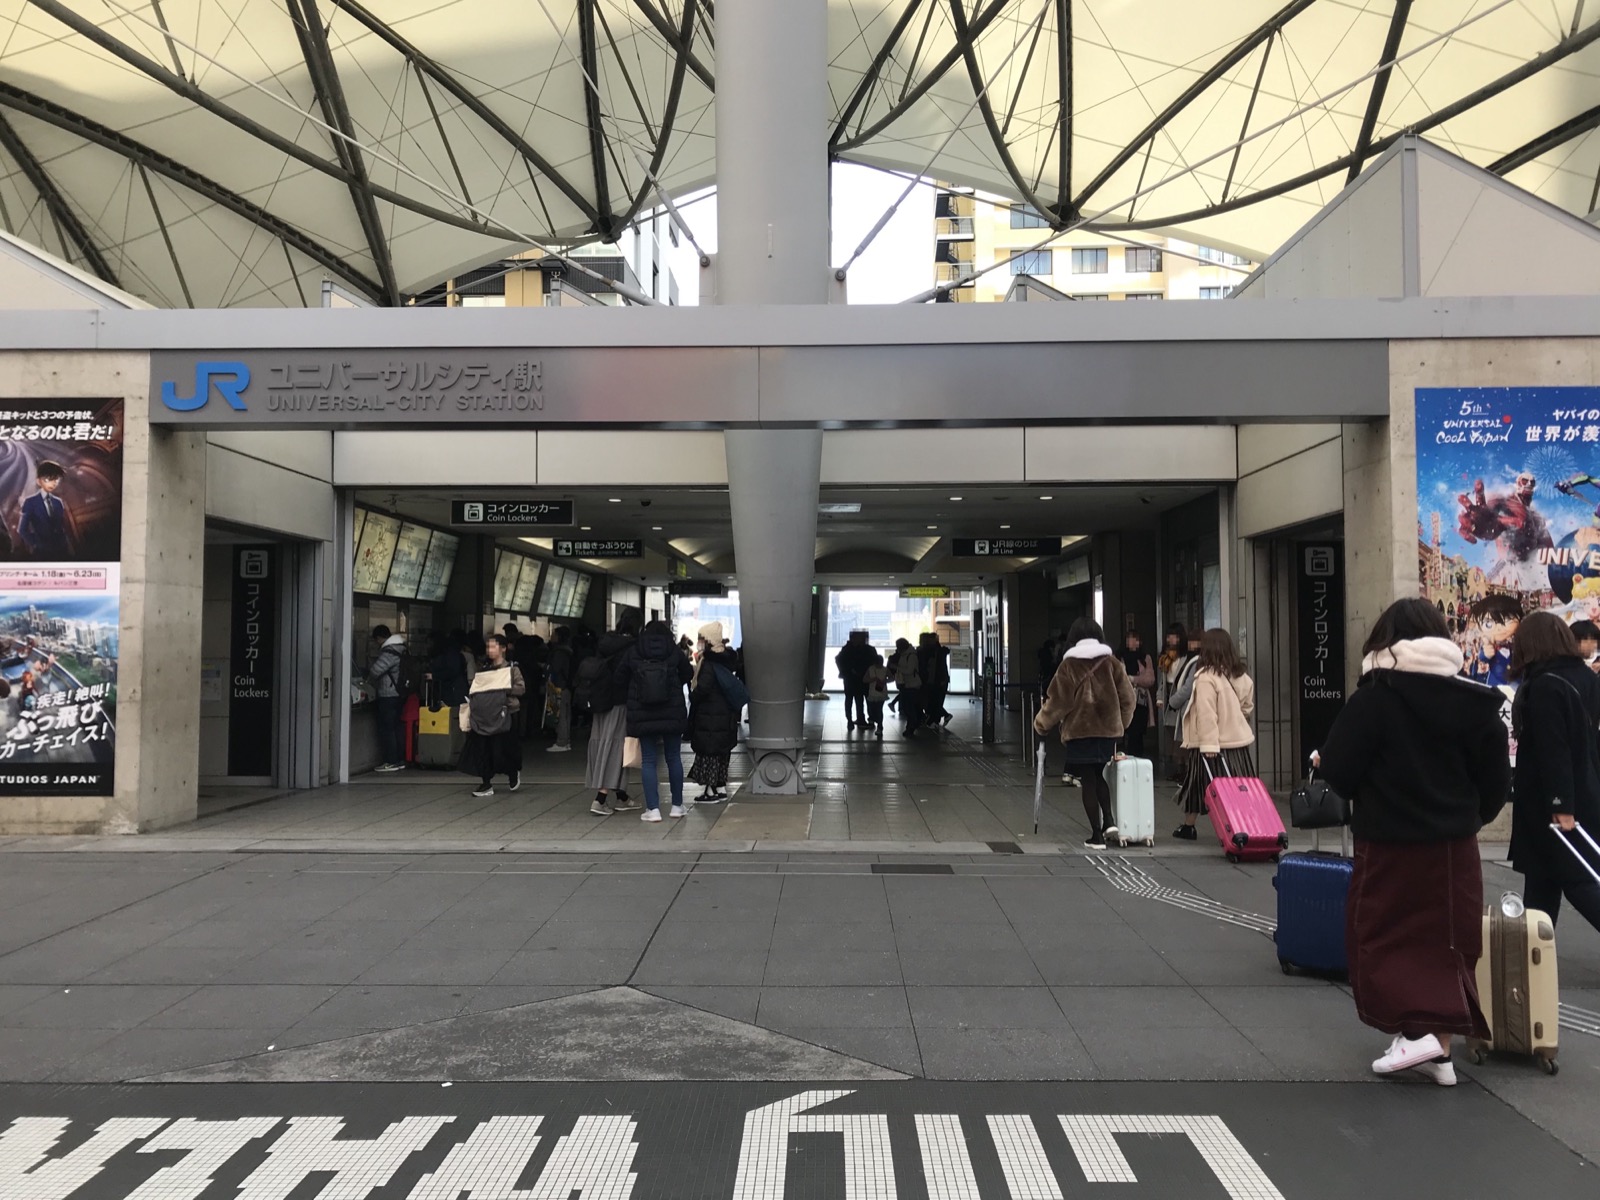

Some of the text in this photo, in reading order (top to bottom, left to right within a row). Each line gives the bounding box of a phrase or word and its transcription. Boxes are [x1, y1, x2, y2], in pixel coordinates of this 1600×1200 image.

[266, 361, 544, 391] ユニバーサルシティ駅
[161, 361, 251, 411] JR
[266, 394, 544, 412] UNIVERSAL-CITY STATION
[1553, 409, 1600, 421] ヤバイの
[487, 504, 560, 513] コインロッカー
[487, 514, 538, 522] Coin Lockers
[992, 540, 1038, 549] JR線のりば
[245, 583, 260, 673] コインロッカー
[1313, 581, 1328, 673] コインロッカー
[234, 675, 255, 686] Coin
[1304, 675, 1326, 686] Coin
[234, 688, 269, 698] Lockers
[1304, 688, 1341, 699] Lockers
[6, 700, 103, 741] ぶっ飛び
[53, 775, 97, 784] JAPAN
